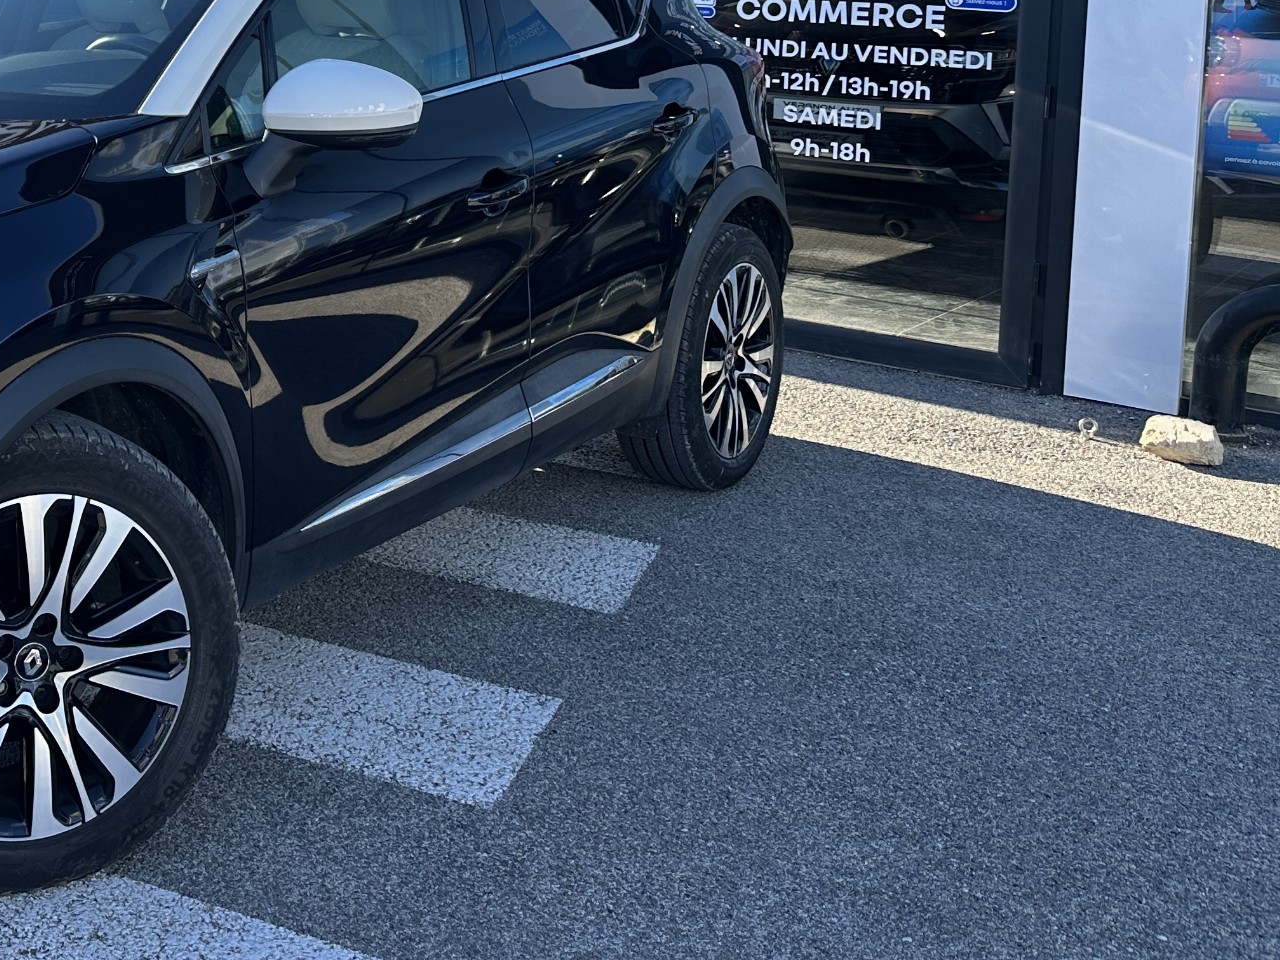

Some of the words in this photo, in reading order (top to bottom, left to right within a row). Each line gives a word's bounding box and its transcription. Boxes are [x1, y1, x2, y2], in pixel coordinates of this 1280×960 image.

[733, 37, 806, 58] UNDI
[811, 40, 849, 61] AU
[854, 44, 993, 71] VENDREDI
[765, 72, 819, 92] -12h
[839, 76, 931, 101] 13h-19h
[783, 105, 882, 131] SAMEDI
[790, 138, 871, 163] 9h-18h
